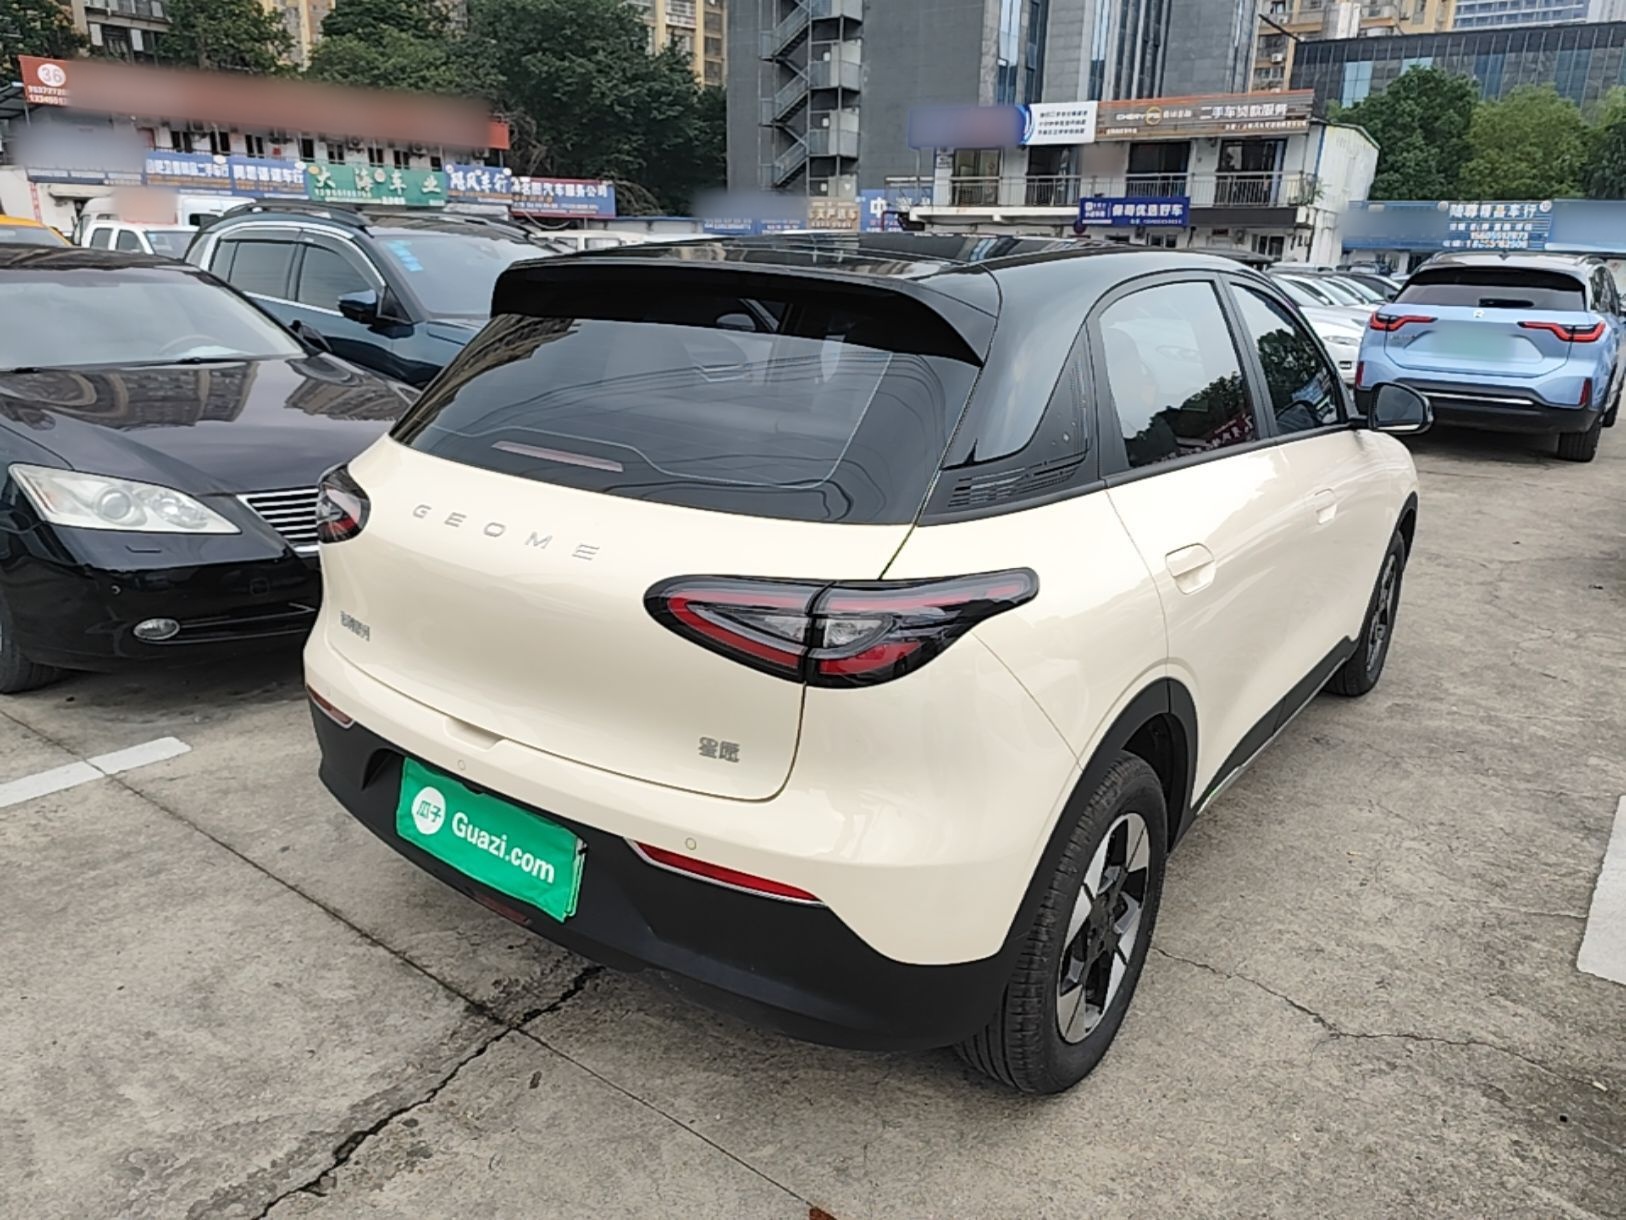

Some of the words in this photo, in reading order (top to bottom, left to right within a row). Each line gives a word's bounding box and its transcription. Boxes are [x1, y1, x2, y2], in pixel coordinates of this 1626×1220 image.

[41, 67, 63, 83] 36
[314, 165, 441, 195] 大海车业
[412, 504, 600, 561] GEOME
[416, 800, 442, 824] 瓜子
[451, 811, 556, 884] Guazi.com
